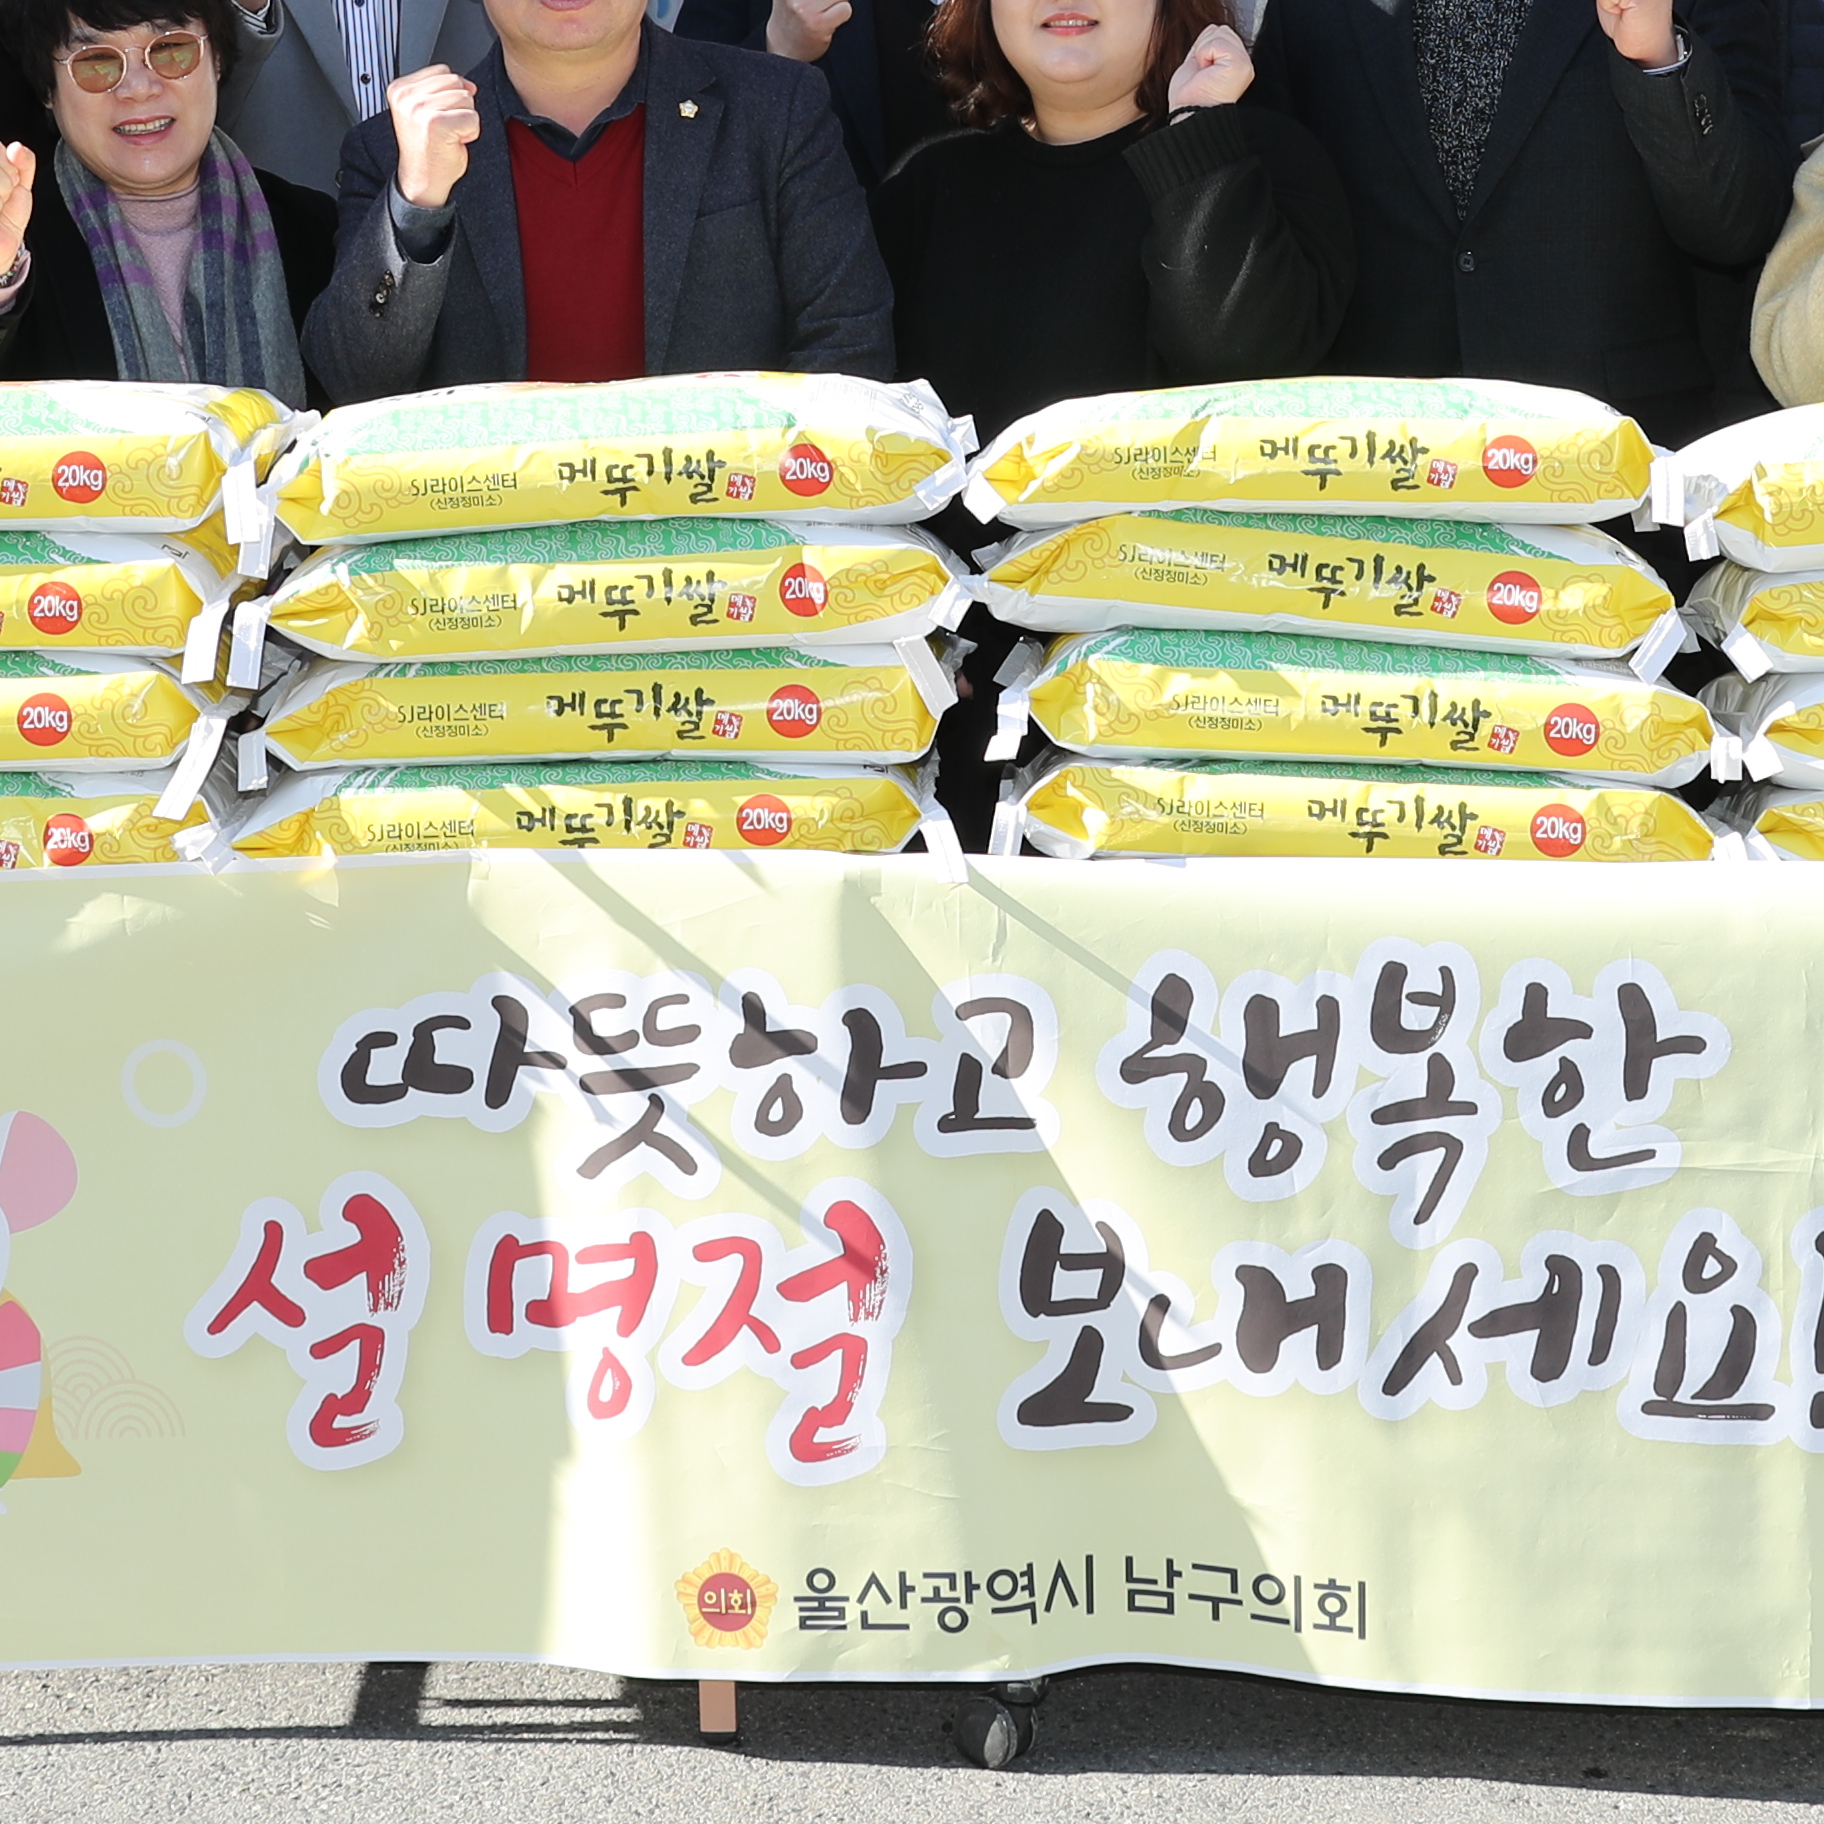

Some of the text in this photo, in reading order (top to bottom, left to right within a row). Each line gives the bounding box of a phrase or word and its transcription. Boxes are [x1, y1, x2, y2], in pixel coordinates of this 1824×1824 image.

[1114, 446, 1217, 465] SJ라이스센터
[1259, 430, 1429, 492] 메뚜기쌀
[1488, 448, 1535, 474] 20kg
[57, 465, 103, 490] 20kg
[558, 447, 727, 507] 메뚜기쌀
[785, 458, 829, 483] 20kg
[410, 475, 517, 497] SJ라이스센터
[557, 567, 727, 631] 메뚜기쌀
[784, 578, 825, 603] 20kg
[1267, 554, 1436, 618] 메뚜기쌀
[1493, 581, 1538, 611] 20kg
[33, 595, 78, 621] 20kg
[397, 702, 505, 724] SJ라이스센터
[546, 683, 715, 743] 메뚜기쌀
[771, 698, 816, 725] 20kg
[1171, 694, 1279, 717] SJ라이스센터
[22, 707, 68, 733] 20kg
[1321, 690, 1491, 752] 메뚜기쌀
[1550, 717, 1595, 744] 20kg
[741, 808, 788, 834] 20kg
[1157, 797, 1265, 820] SJ라이스센터
[367, 820, 474, 842] SJ라이스센터
[516, 795, 686, 849] 메뚜기쌀
[1307, 795, 1478, 856] 메뚜기쌀
[1536, 817, 1581, 843] 20kg
[47, 827, 89, 853] 20kg
[341, 960, 1707, 1225] 따뜻하고 행복한
[207, 1193, 407, 1448] 설
[486, 1200, 891, 1464] 명절
[701, 1587, 752, 1615] 의회
[793, 1554, 1367, 1641] 울산광역시 남구의회
